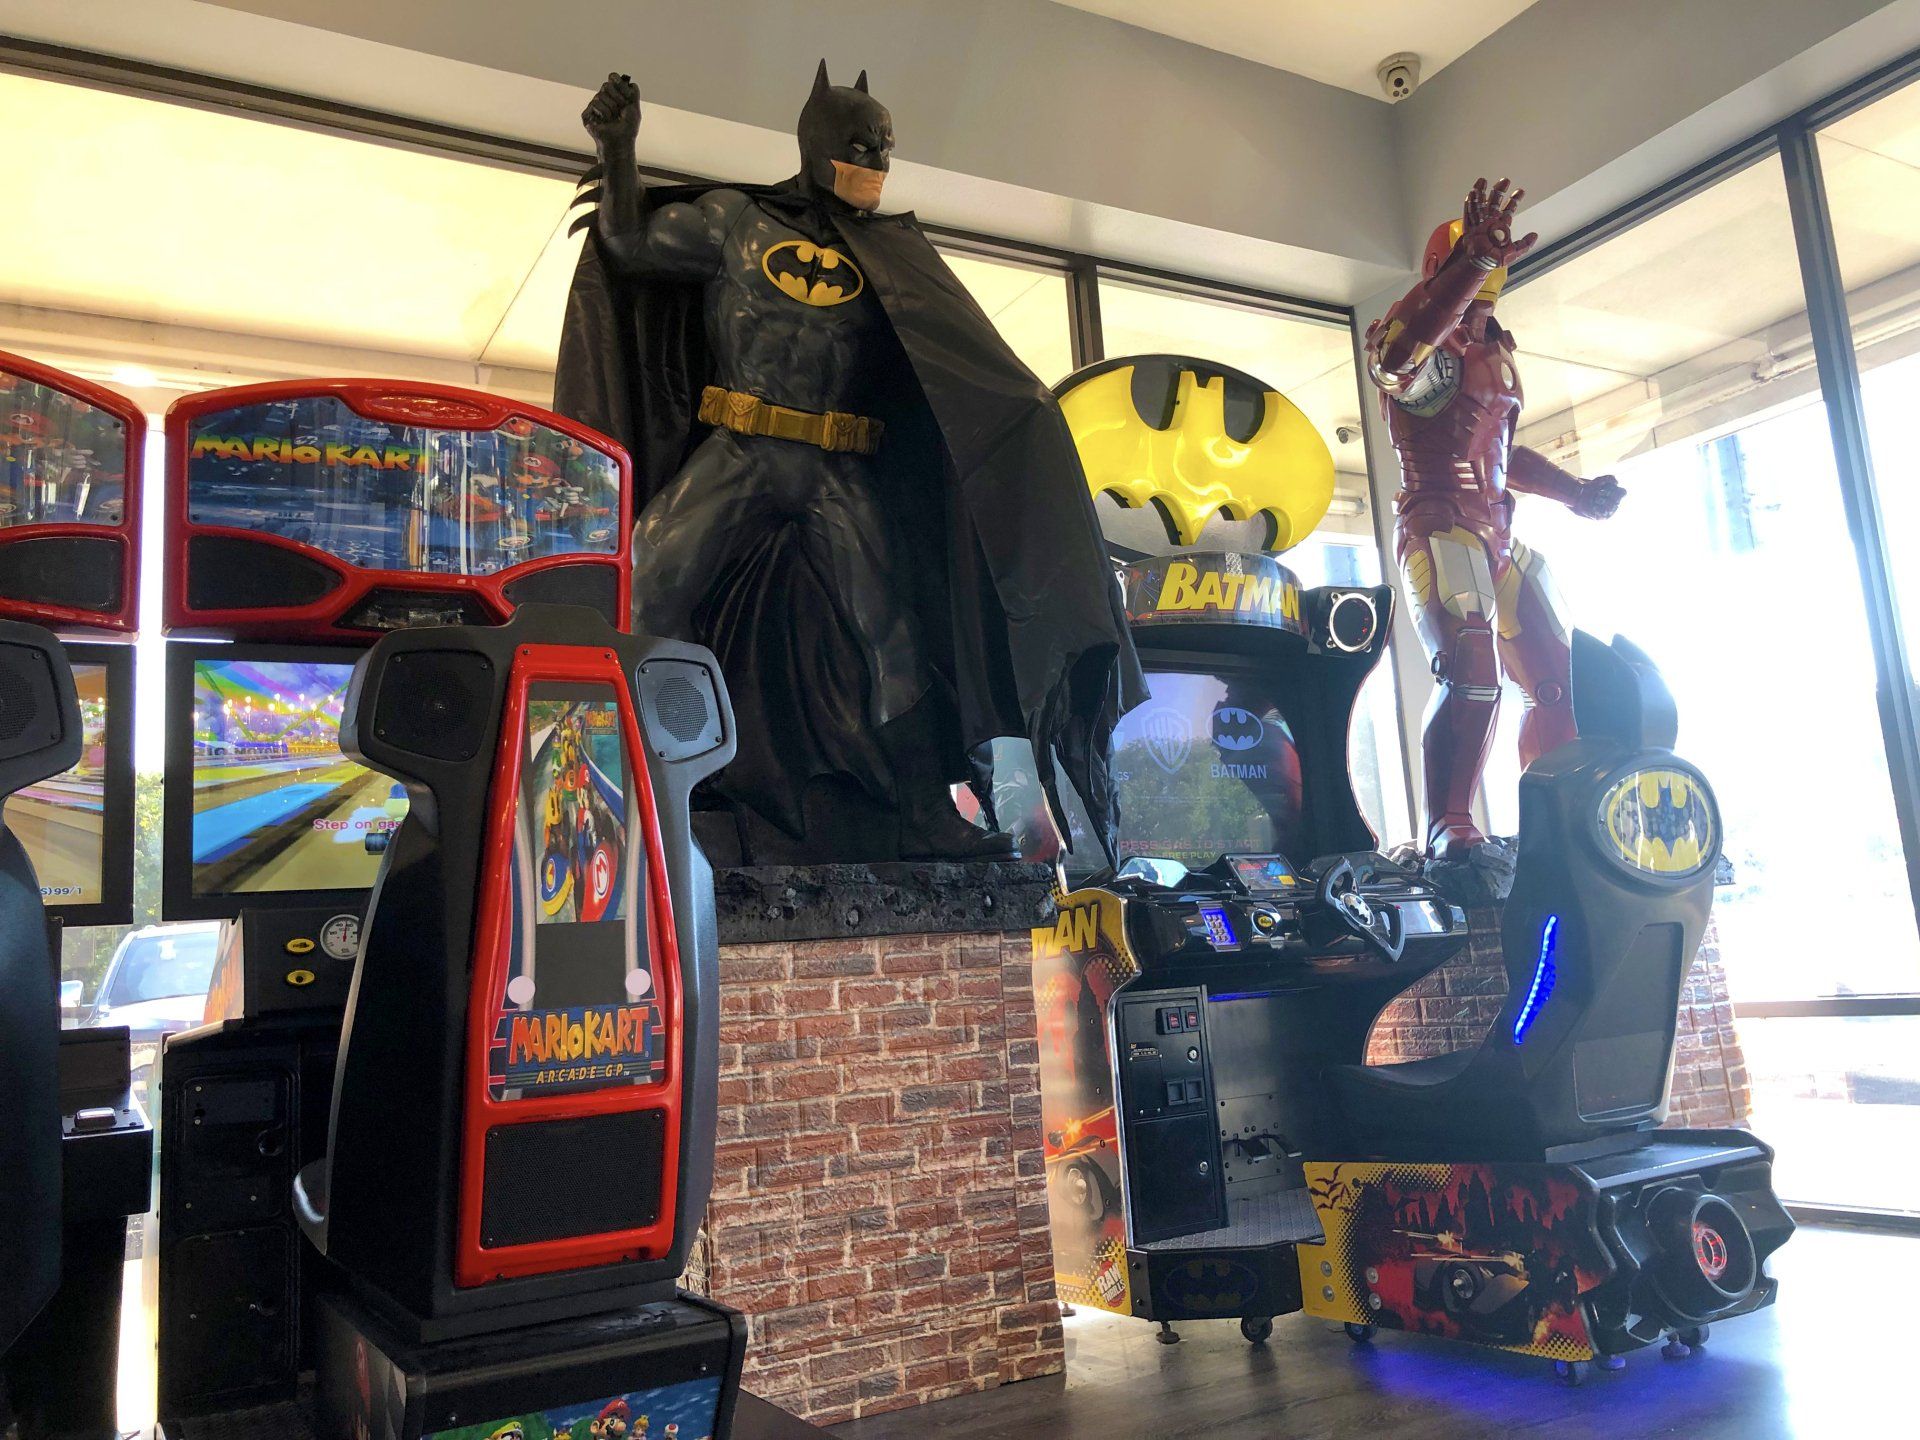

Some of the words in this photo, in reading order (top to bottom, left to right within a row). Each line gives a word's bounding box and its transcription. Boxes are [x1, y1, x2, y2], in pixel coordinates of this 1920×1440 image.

[1156, 563, 1299, 620] BATMAN
[1210, 764, 1267, 779] BATMAN
[313, 819, 349, 830] Step
[355, 821, 373, 830] on
[1119, 839, 1158, 850] RESS
[1216, 838, 1262, 849] START
[1162, 851, 1189, 860] FREE
[1190, 851, 1217, 859] PLAY
[1031, 904, 1098, 958] MAN
[536, 1066, 597, 1084] ARCADE
[605, 1063, 623, 1077] GP
[1097, 1263, 1121, 1295] RAW
